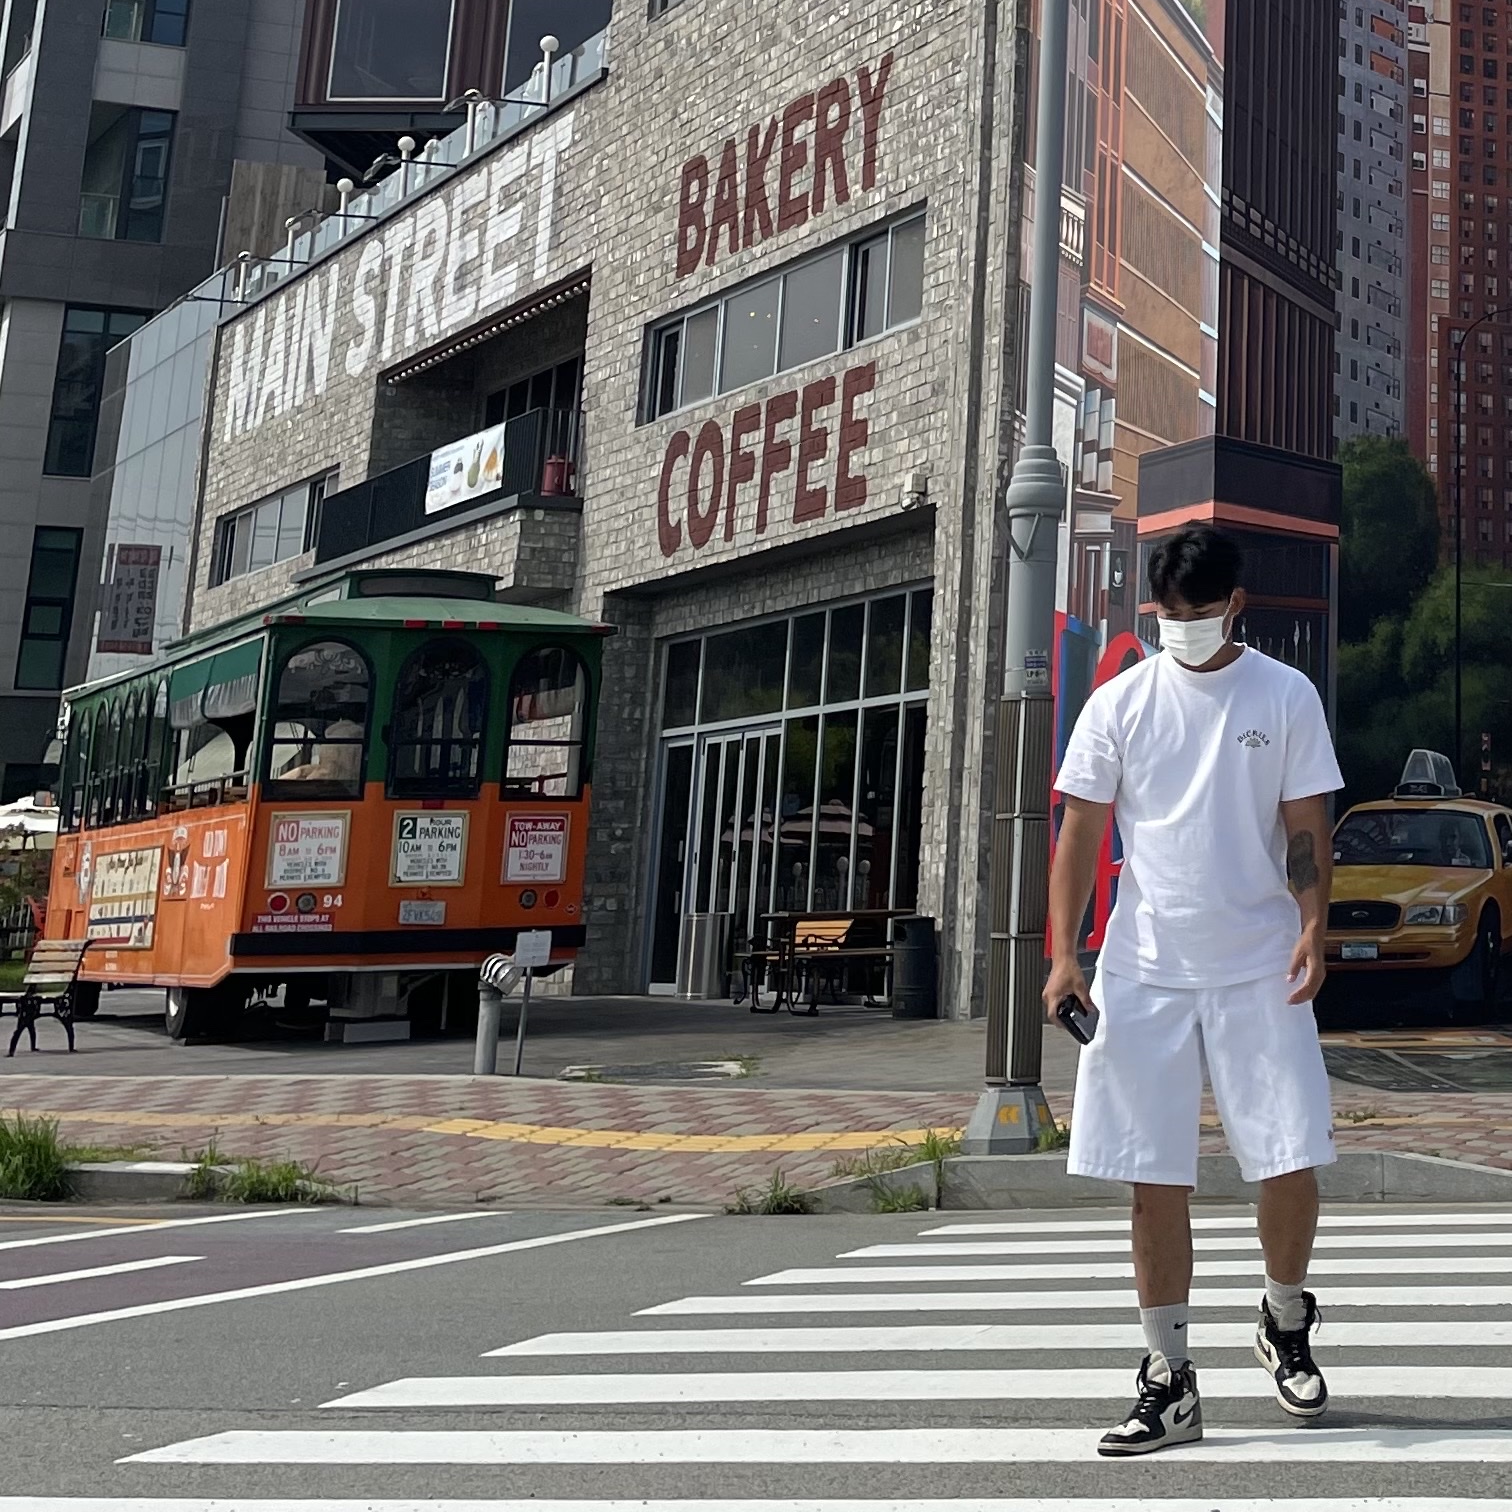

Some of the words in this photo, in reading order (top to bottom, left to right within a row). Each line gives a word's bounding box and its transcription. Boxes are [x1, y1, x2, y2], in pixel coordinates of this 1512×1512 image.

[675, 51, 895, 279] BAKERY
[223, 263, 340, 442] MAIN
[346, 110, 575, 378] STREET
[656, 360, 876, 558] COFFEE
[278, 822, 298, 841] NO
[300, 826, 340, 840] PARKING
[402, 819, 413, 838] 2
[419, 826, 461, 839] PARKING
[514, 821, 562, 831] TOW-AWAY
[511, 831, 527, 846] NO
[529, 834, 562, 845] PARKING
[519, 862, 550, 871] NIGHTLY
[323, 894, 343, 908] 94
